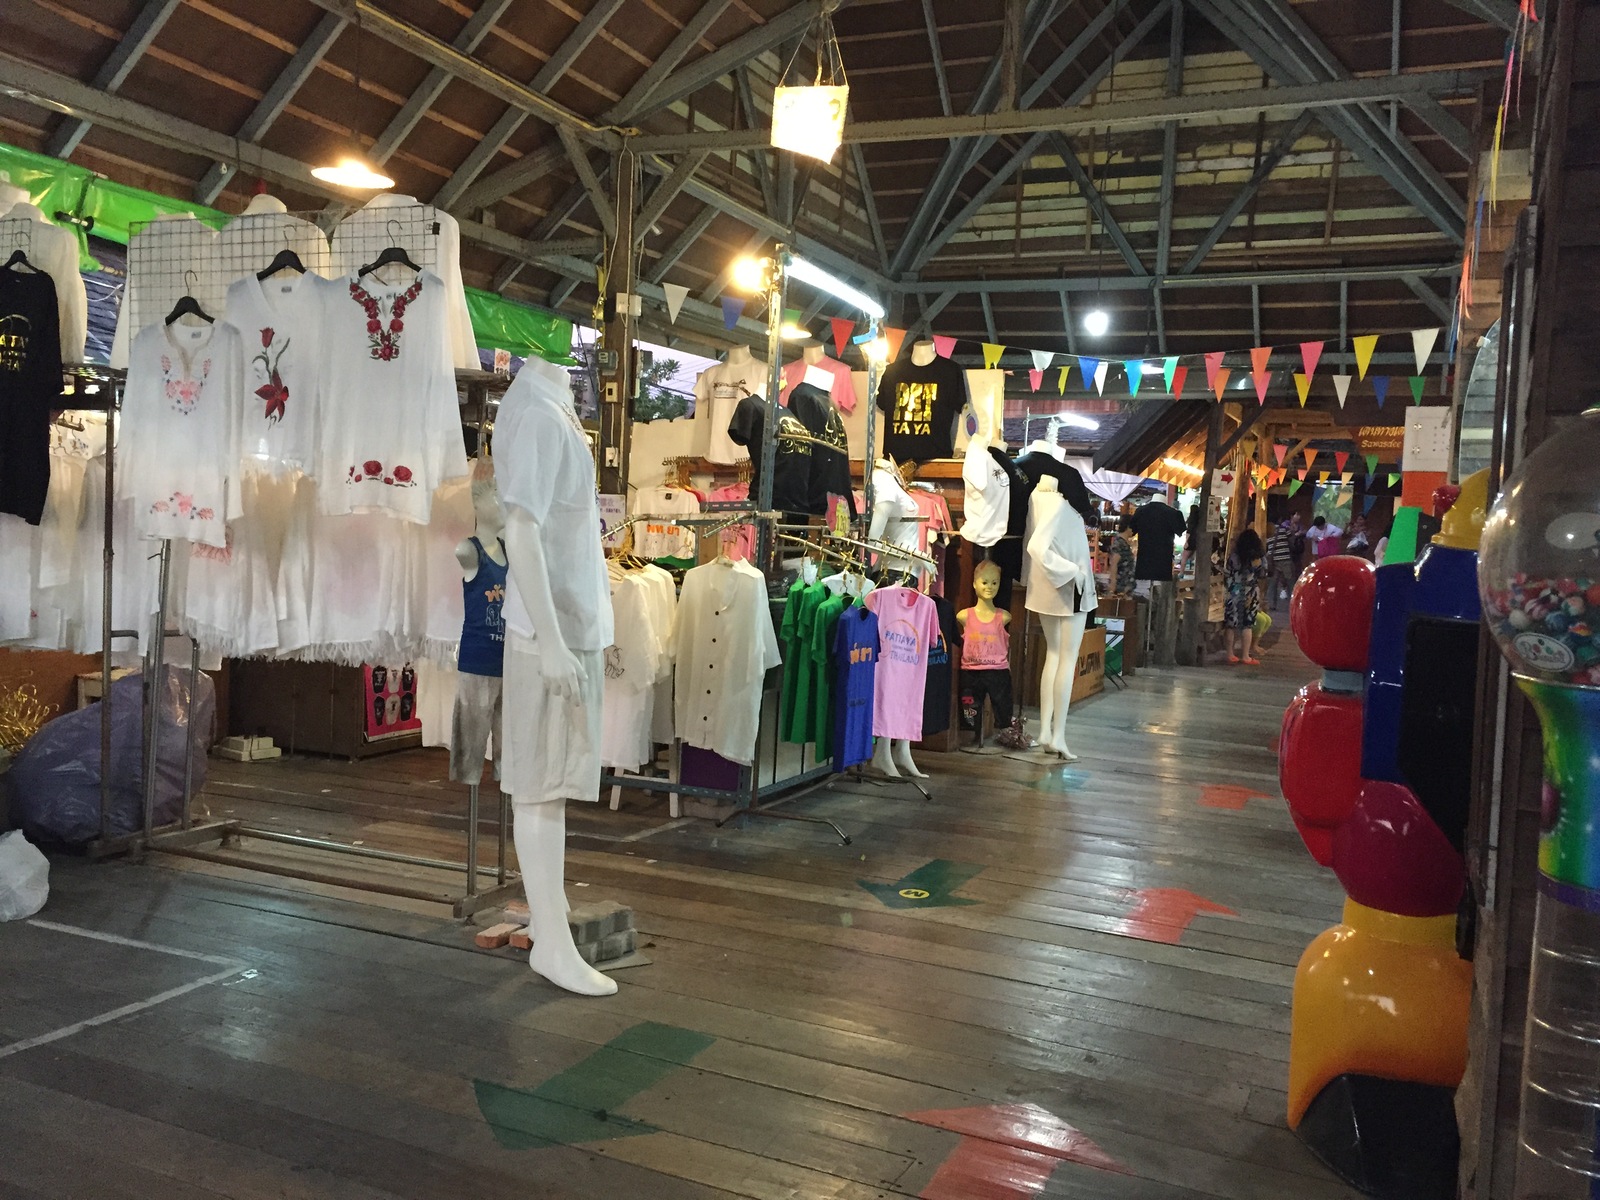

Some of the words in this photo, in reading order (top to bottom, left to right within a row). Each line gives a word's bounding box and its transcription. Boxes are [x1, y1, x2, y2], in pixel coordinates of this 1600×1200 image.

[490, 633, 505, 641] TH
[884, 630, 916, 647] PATTAYA
[890, 650, 919, 665] THAILAND
